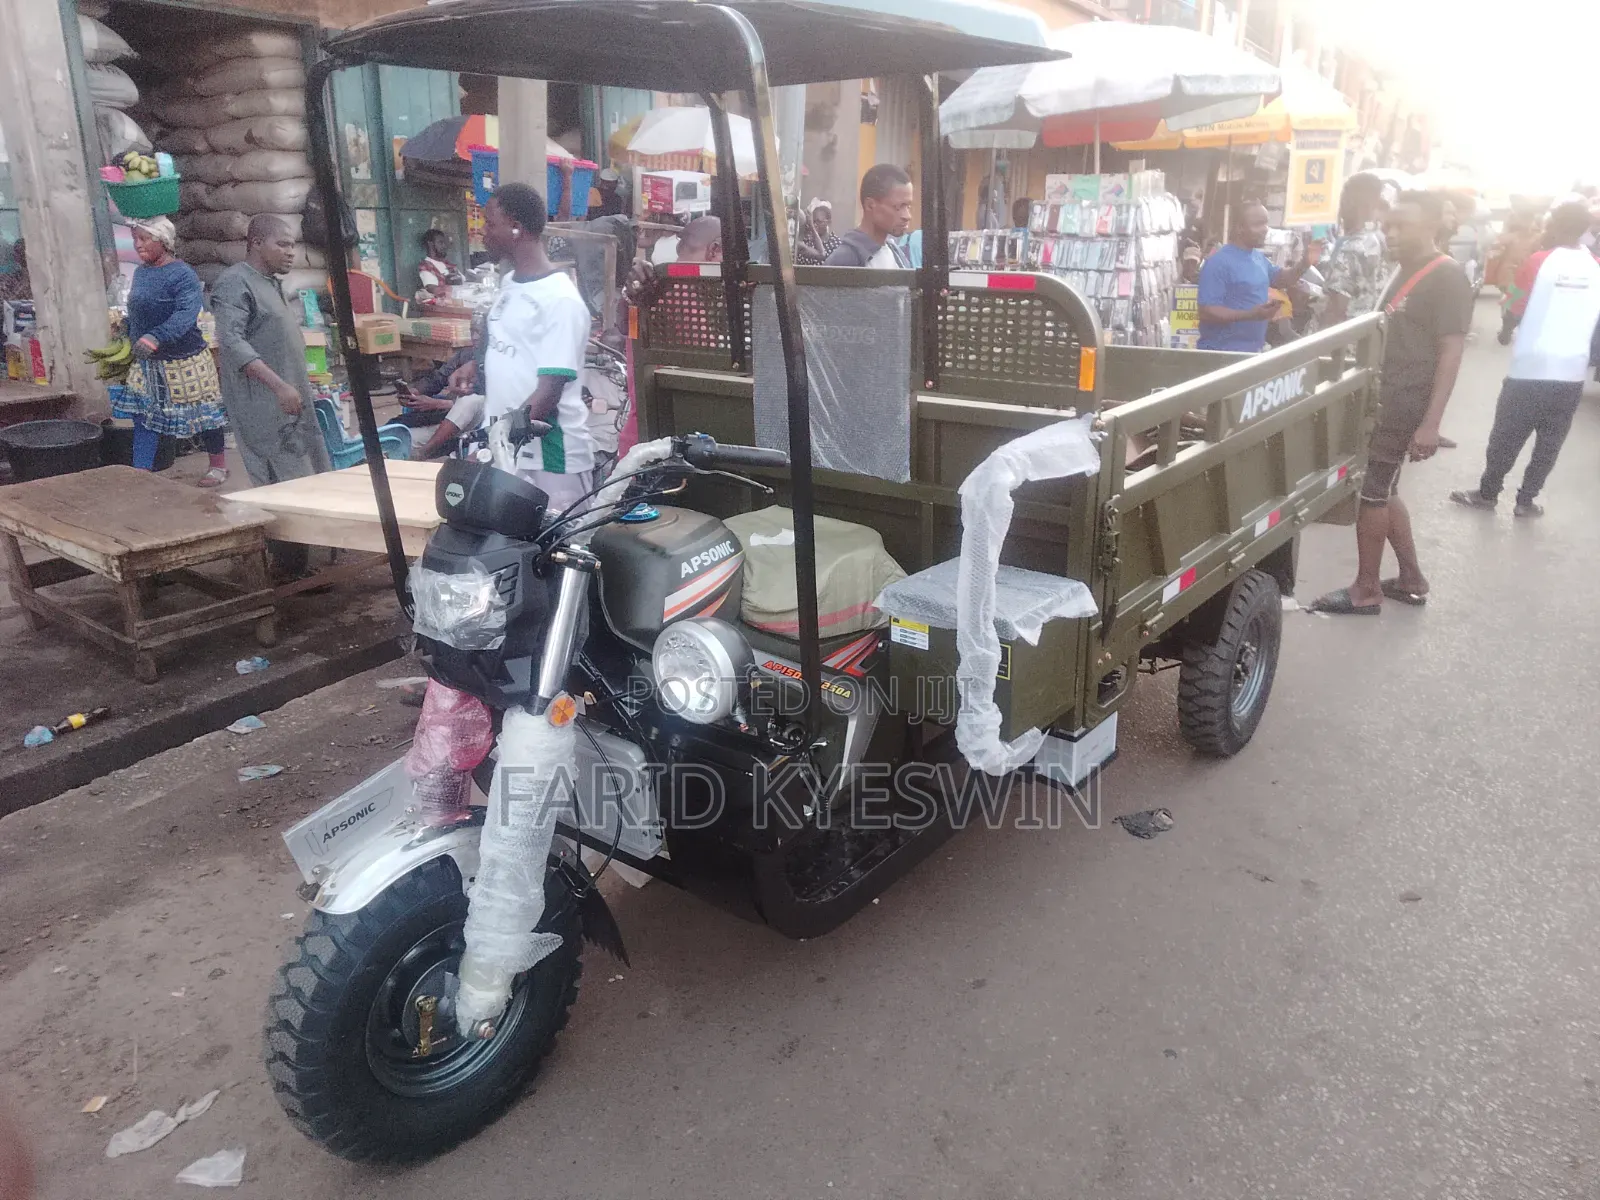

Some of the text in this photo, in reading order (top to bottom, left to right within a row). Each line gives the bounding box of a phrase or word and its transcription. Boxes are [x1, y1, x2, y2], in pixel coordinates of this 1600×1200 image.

[1239, 367, 1307, 423] APSONIC
[681, 540, 735, 579] APSONIC
[322, 802, 376, 843] APSONIC
